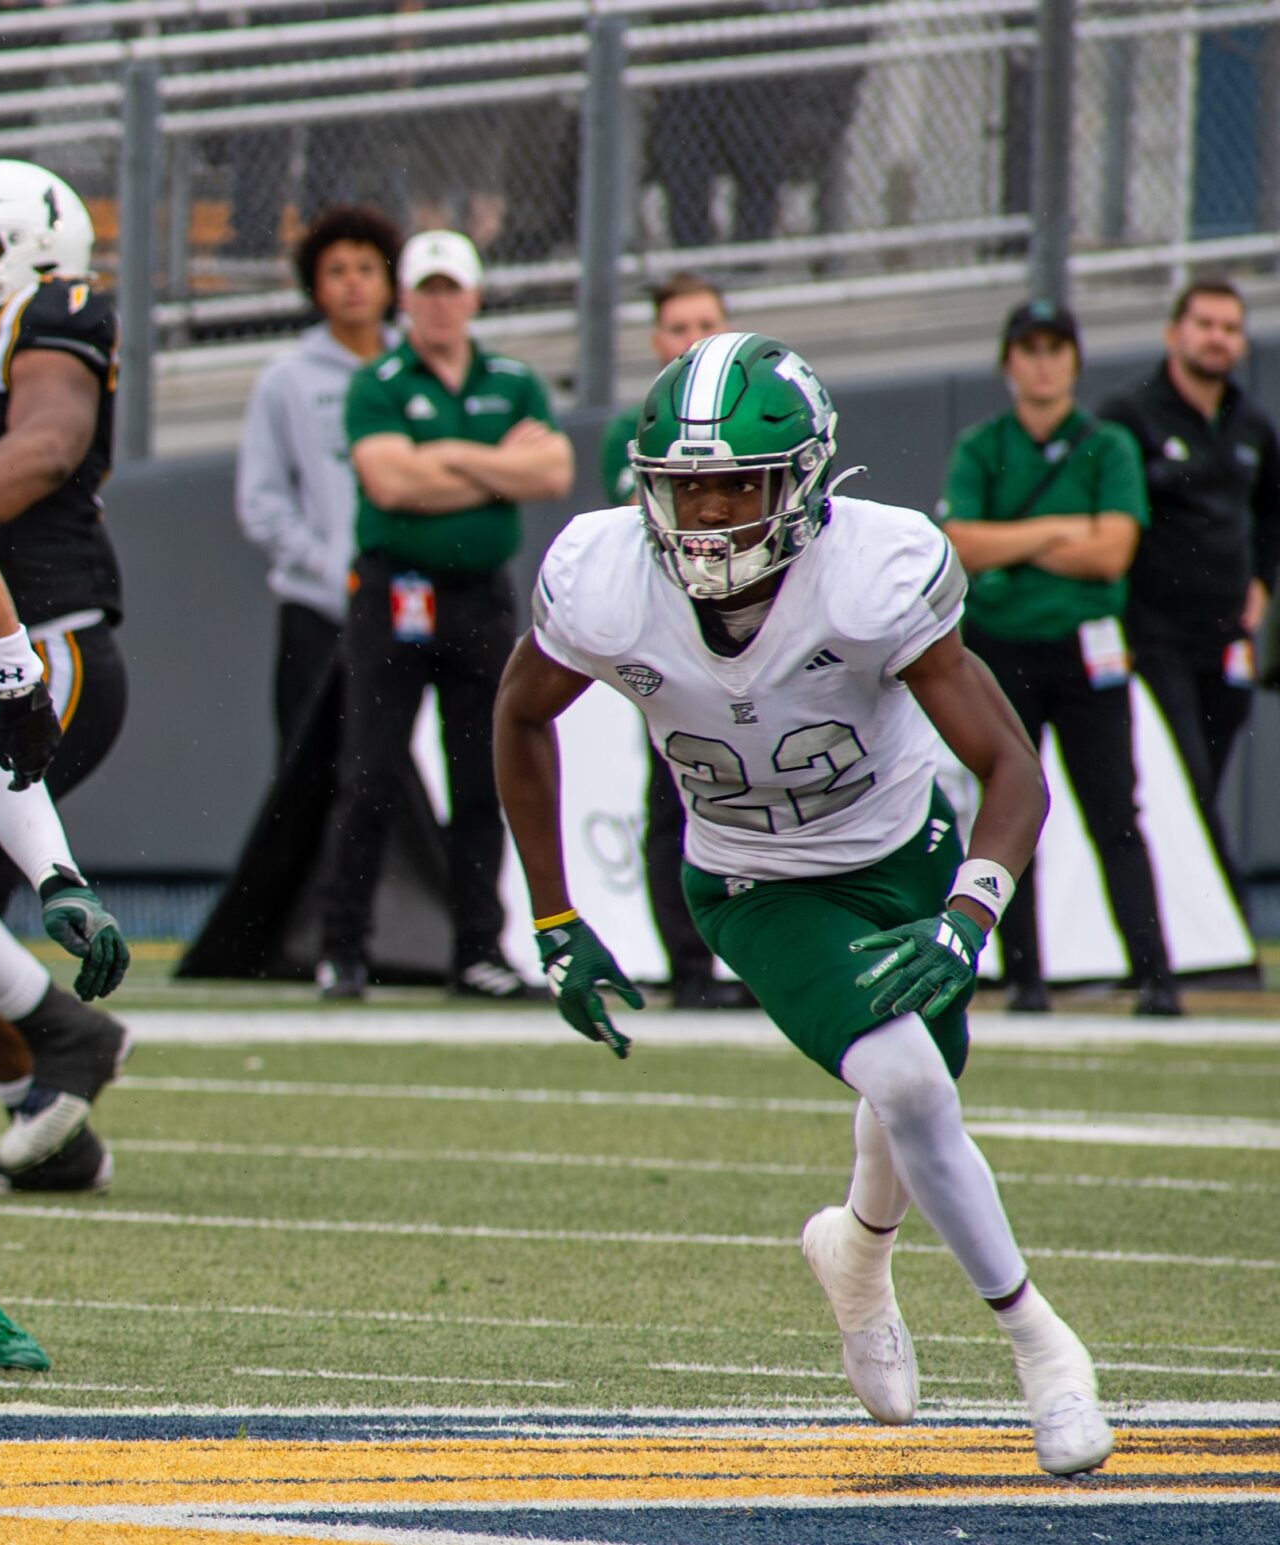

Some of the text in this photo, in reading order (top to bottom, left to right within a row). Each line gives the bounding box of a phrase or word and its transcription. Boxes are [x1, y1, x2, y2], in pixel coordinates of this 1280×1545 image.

[730, 701, 759, 725] E
[665, 719, 877, 835] 22
[973, 879, 1001, 899] adidas
